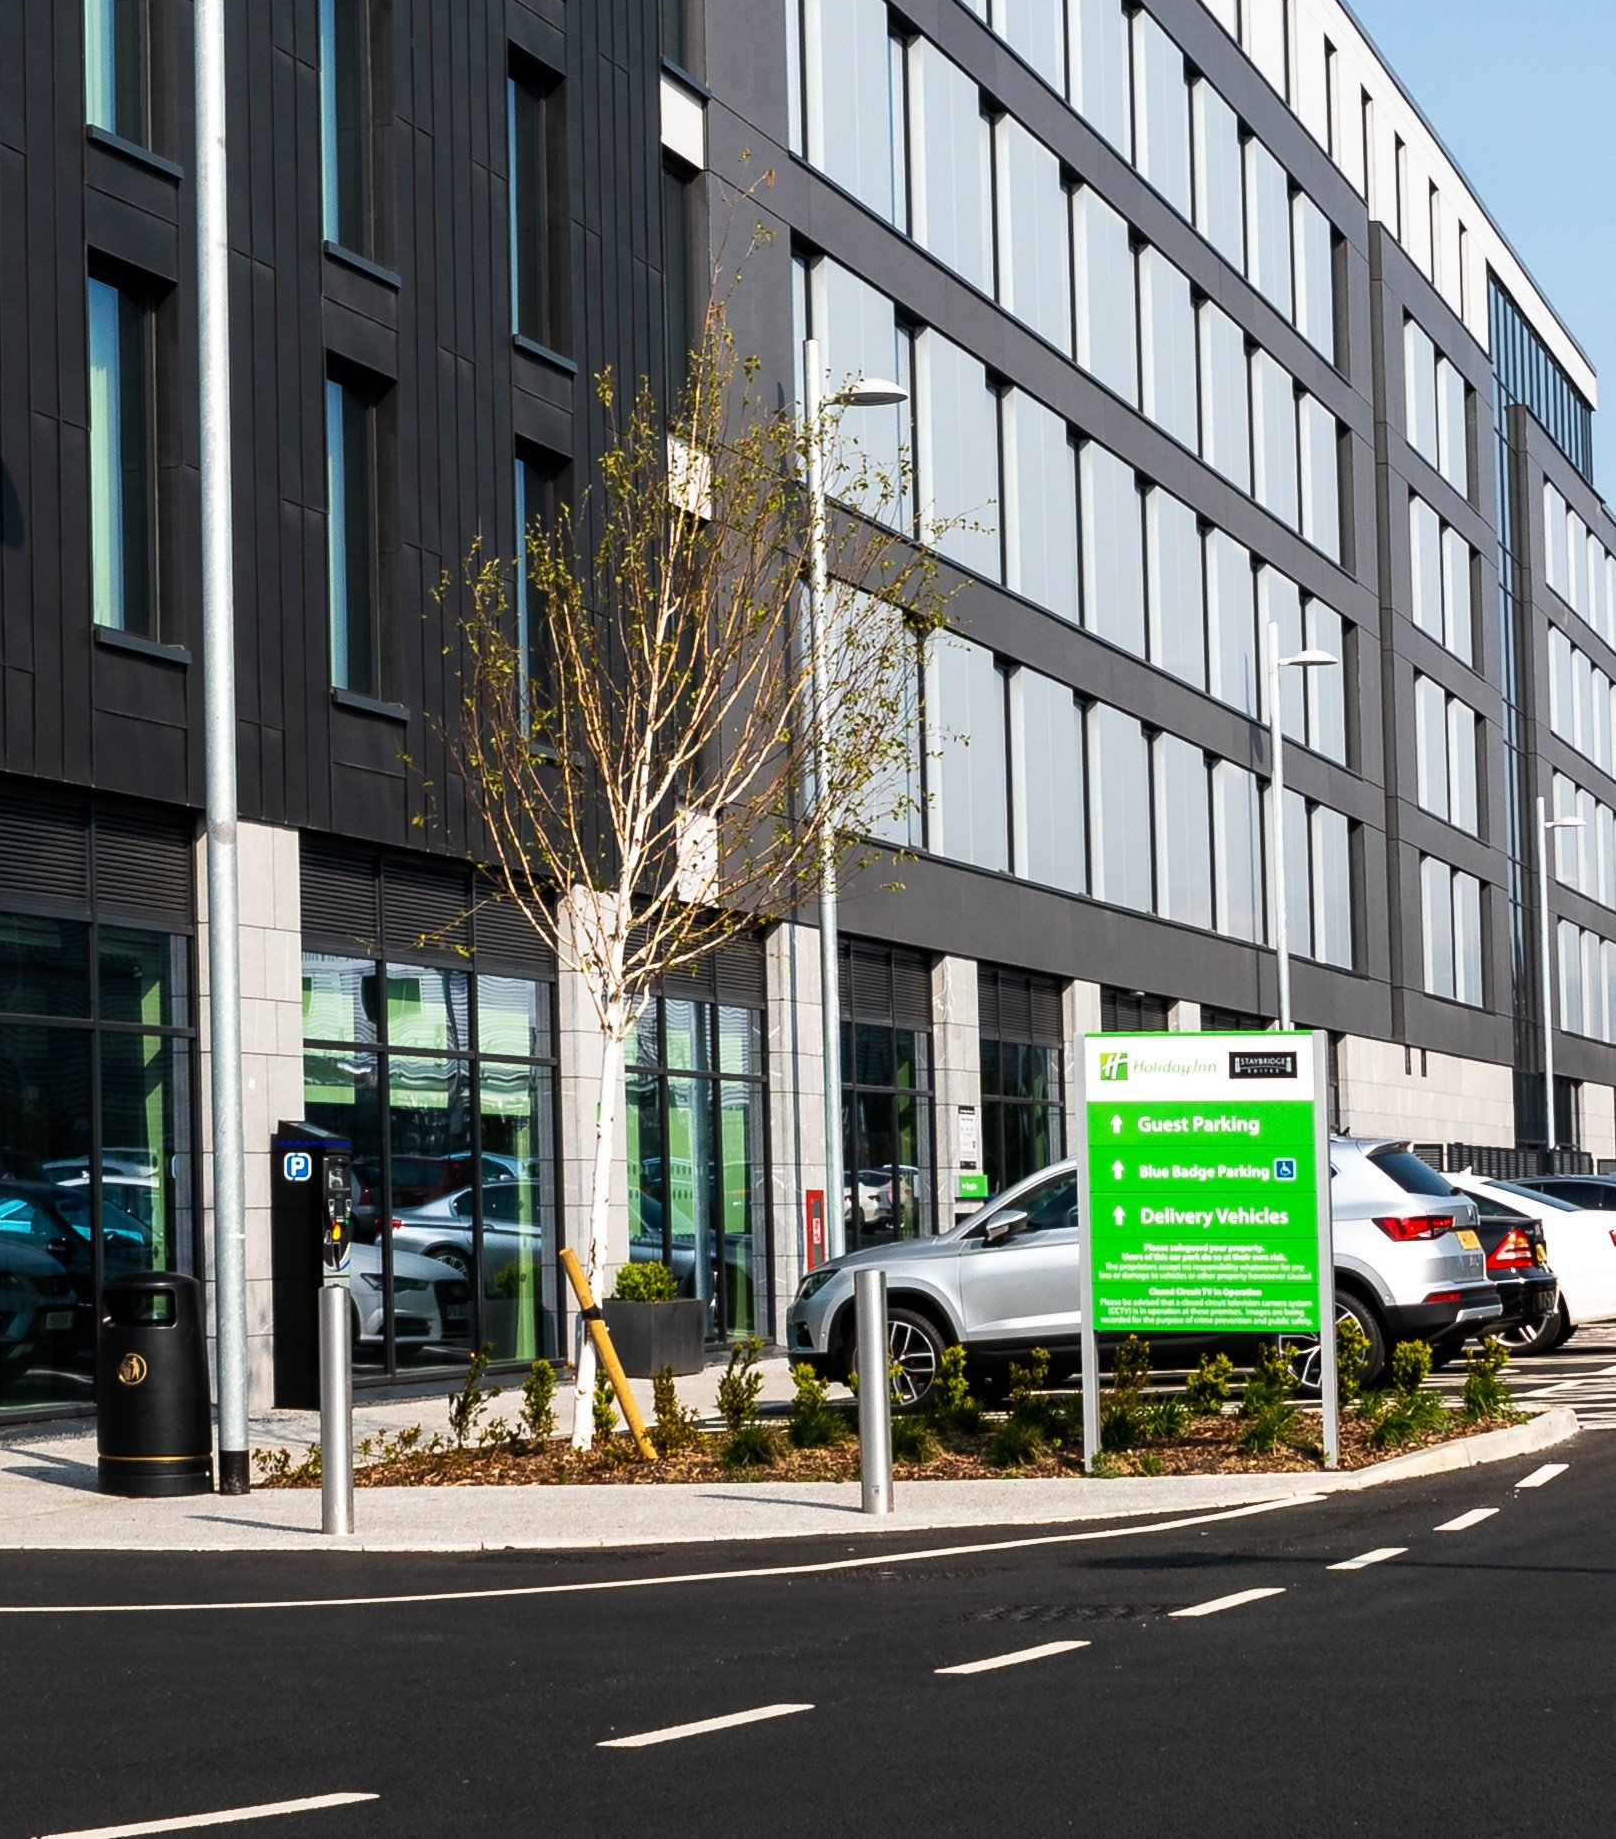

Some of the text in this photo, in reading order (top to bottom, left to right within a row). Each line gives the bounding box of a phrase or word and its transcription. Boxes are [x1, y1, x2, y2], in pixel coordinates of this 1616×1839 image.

[1133, 1059, 1191, 1076] Holiday
[1194, 1059, 1218, 1074] Inn
[1138, 1115, 1261, 1136] Guest Parking
[1139, 1164, 1270, 1182] Blue Badge Parking
[1140, 1207, 1289, 1229] Delivery Vehicles
[1202, 1288, 1214, 1296] TV
